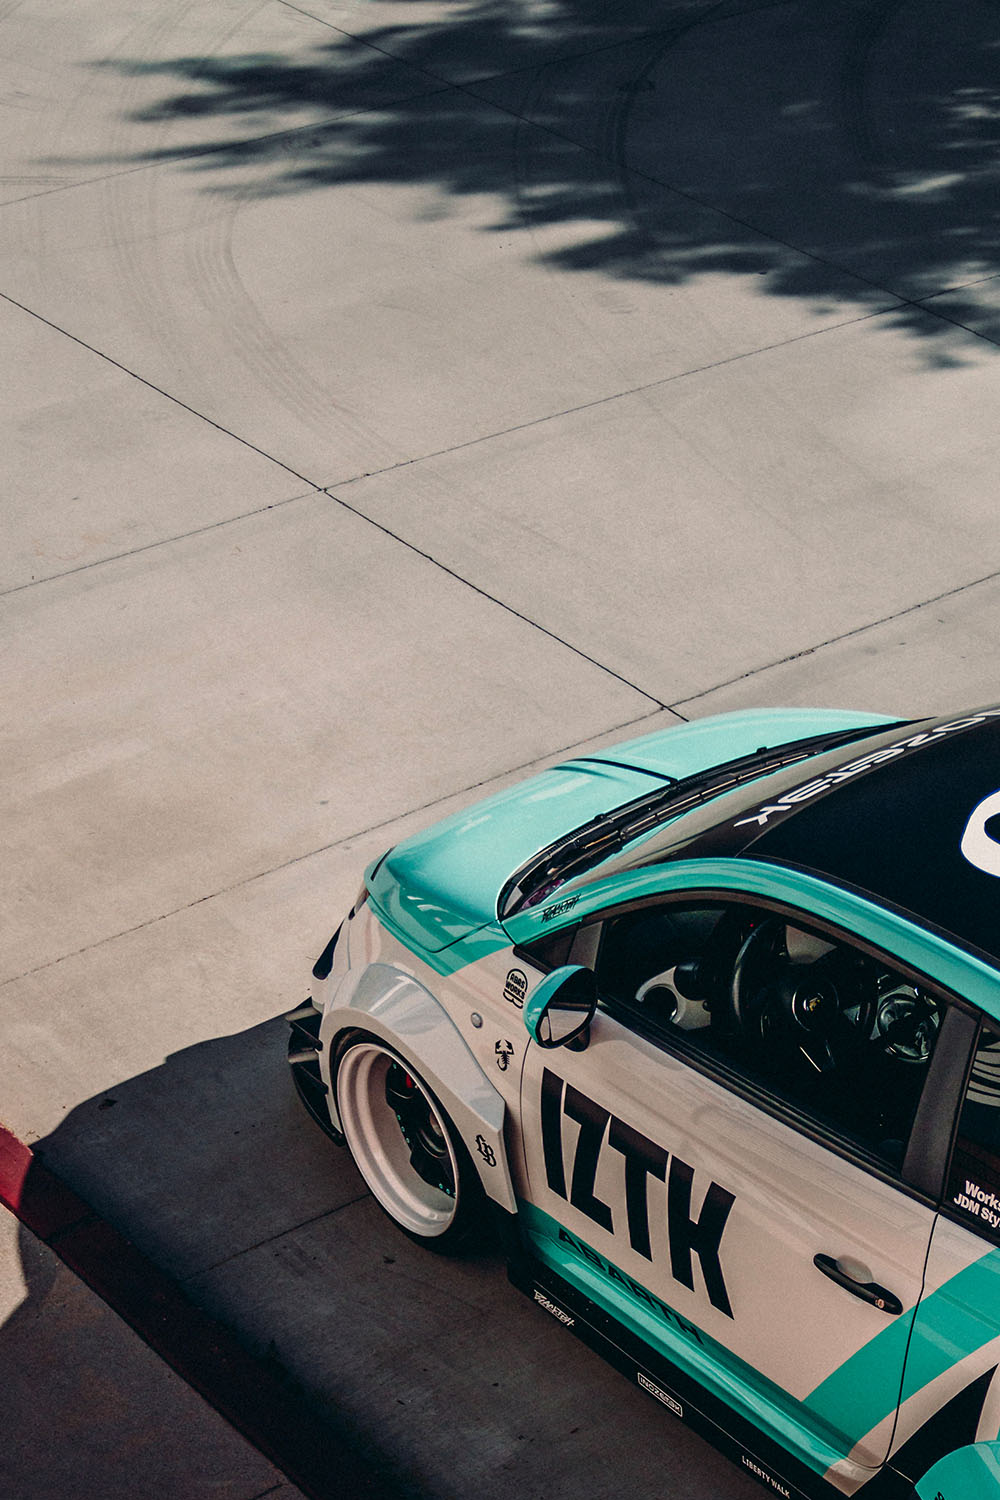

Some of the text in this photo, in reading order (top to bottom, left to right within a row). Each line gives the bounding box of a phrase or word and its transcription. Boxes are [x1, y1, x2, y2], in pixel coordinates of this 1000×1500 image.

[541, 1066, 737, 1321] IZTK
[953, 1193, 980, 1216] JDM
[741, 1455, 790, 1500] LIBERTY WALK
